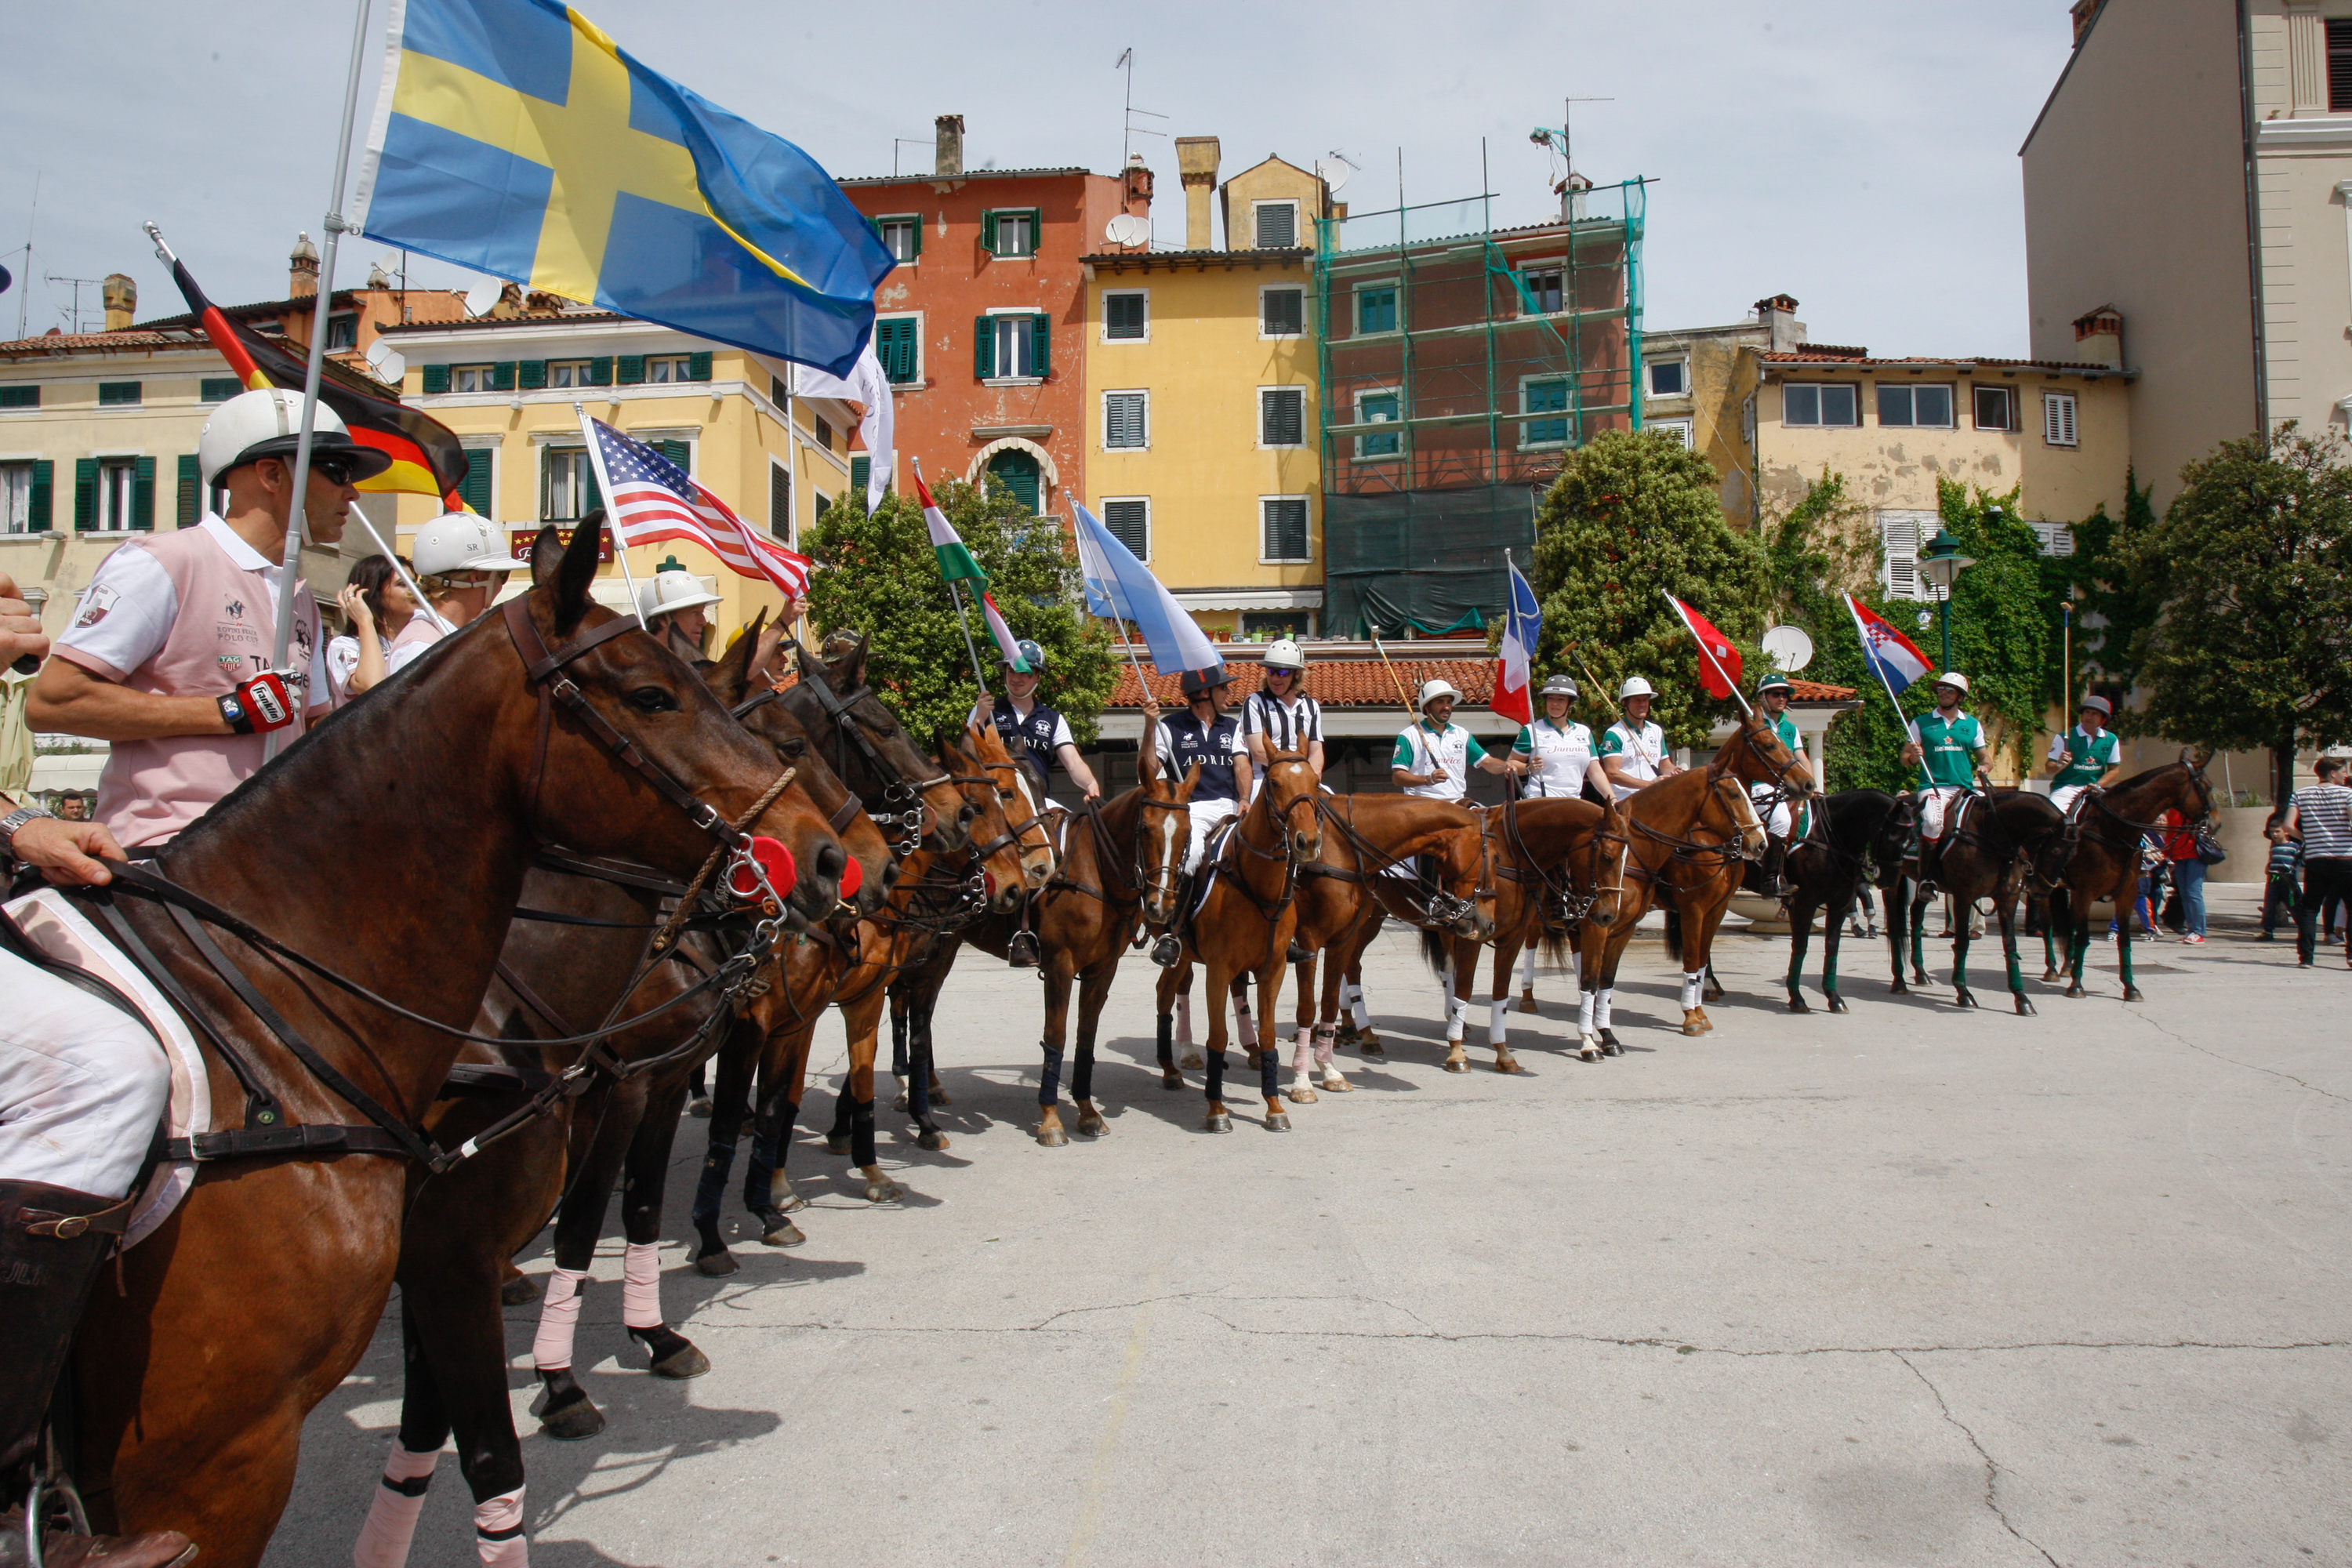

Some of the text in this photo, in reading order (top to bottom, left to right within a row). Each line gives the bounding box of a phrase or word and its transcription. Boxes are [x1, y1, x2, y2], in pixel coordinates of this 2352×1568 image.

[220, 662, 240, 672] HEUER
[249, 655, 273, 673] TA
[1182, 754, 1233, 767] ADRIS
